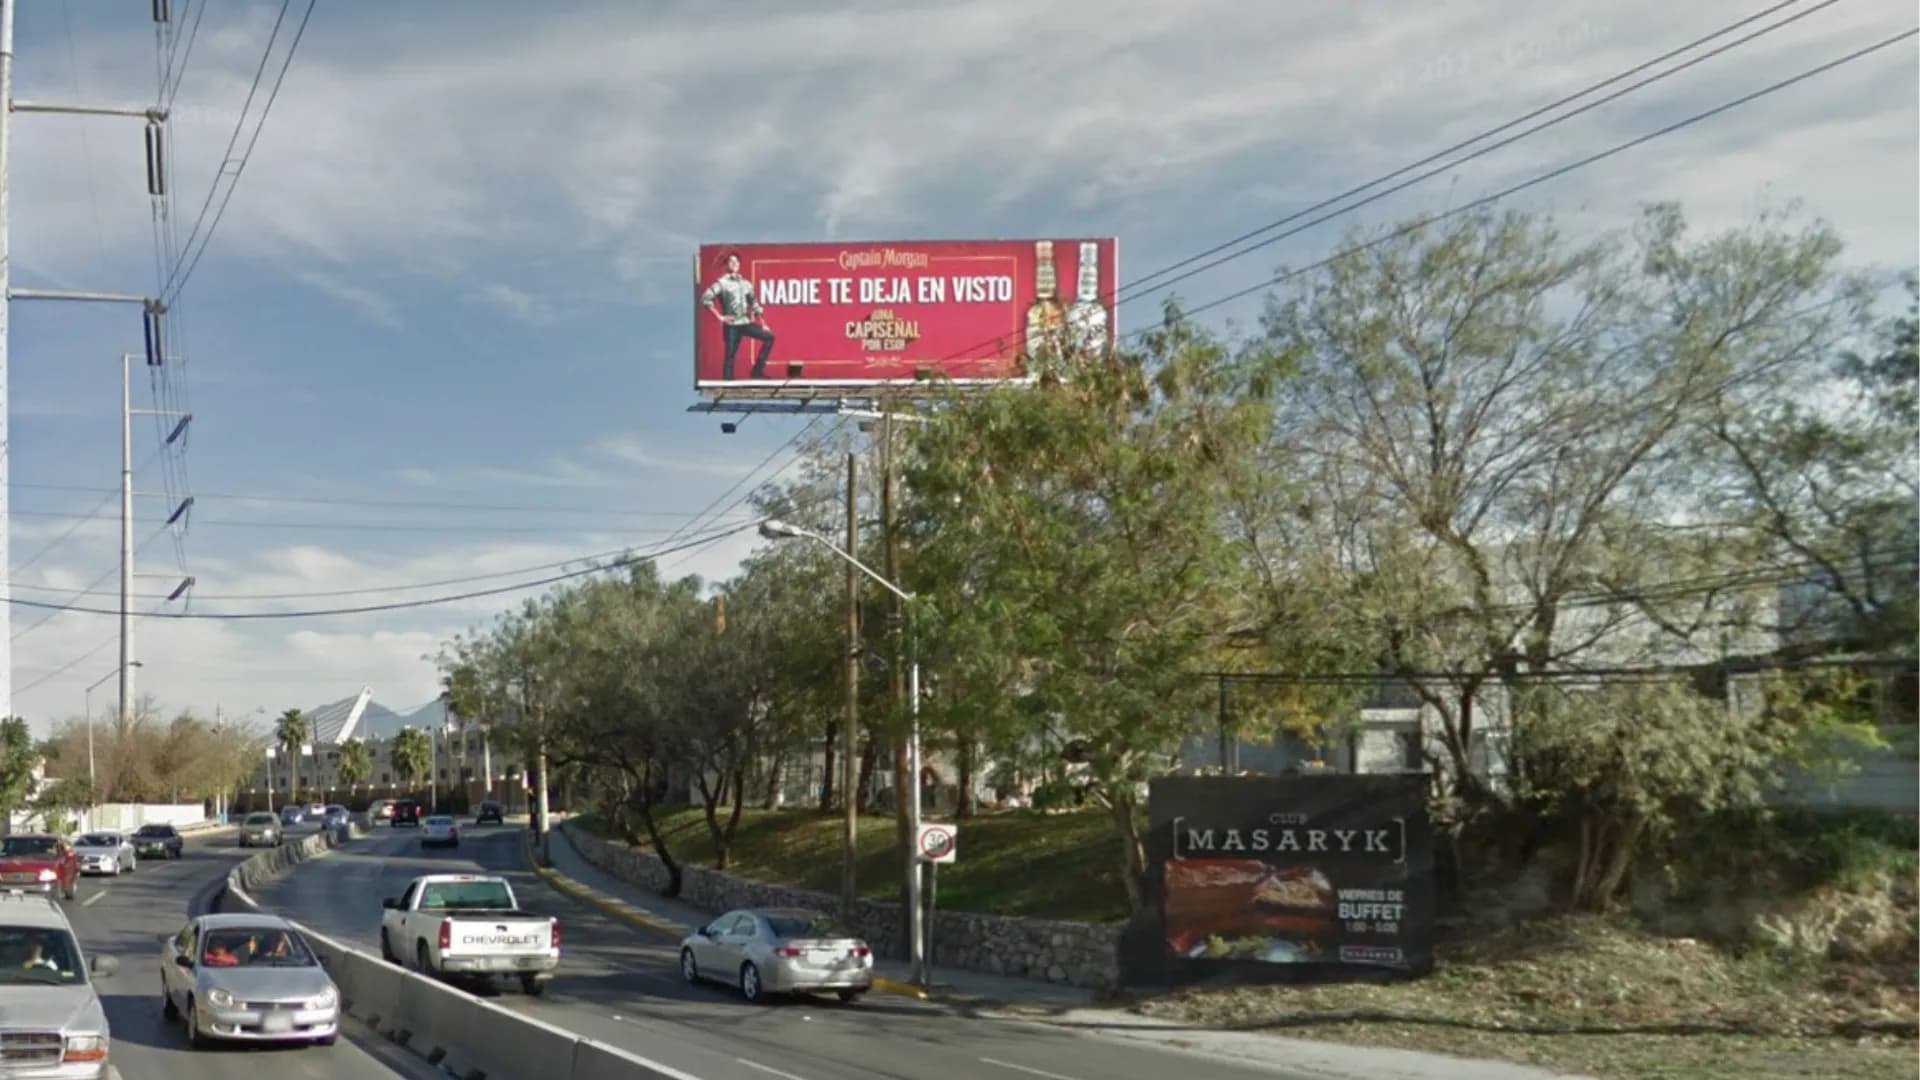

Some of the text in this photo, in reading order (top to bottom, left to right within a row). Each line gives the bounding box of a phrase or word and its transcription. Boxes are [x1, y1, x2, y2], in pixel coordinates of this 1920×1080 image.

[839, 247, 928, 270] Captain Morgan
[760, 278, 821, 304] NADIE
[828, 277, 853, 303] TE
[860, 277, 912, 303] DEJA
[918, 276, 945, 302] EN
[952, 275, 1013, 302] VISTO
[1187, 828, 1389, 851] MASARYK
[1338, 903, 1404, 920] BUFFET
[462, 935, 540, 944] CHEVROLET
